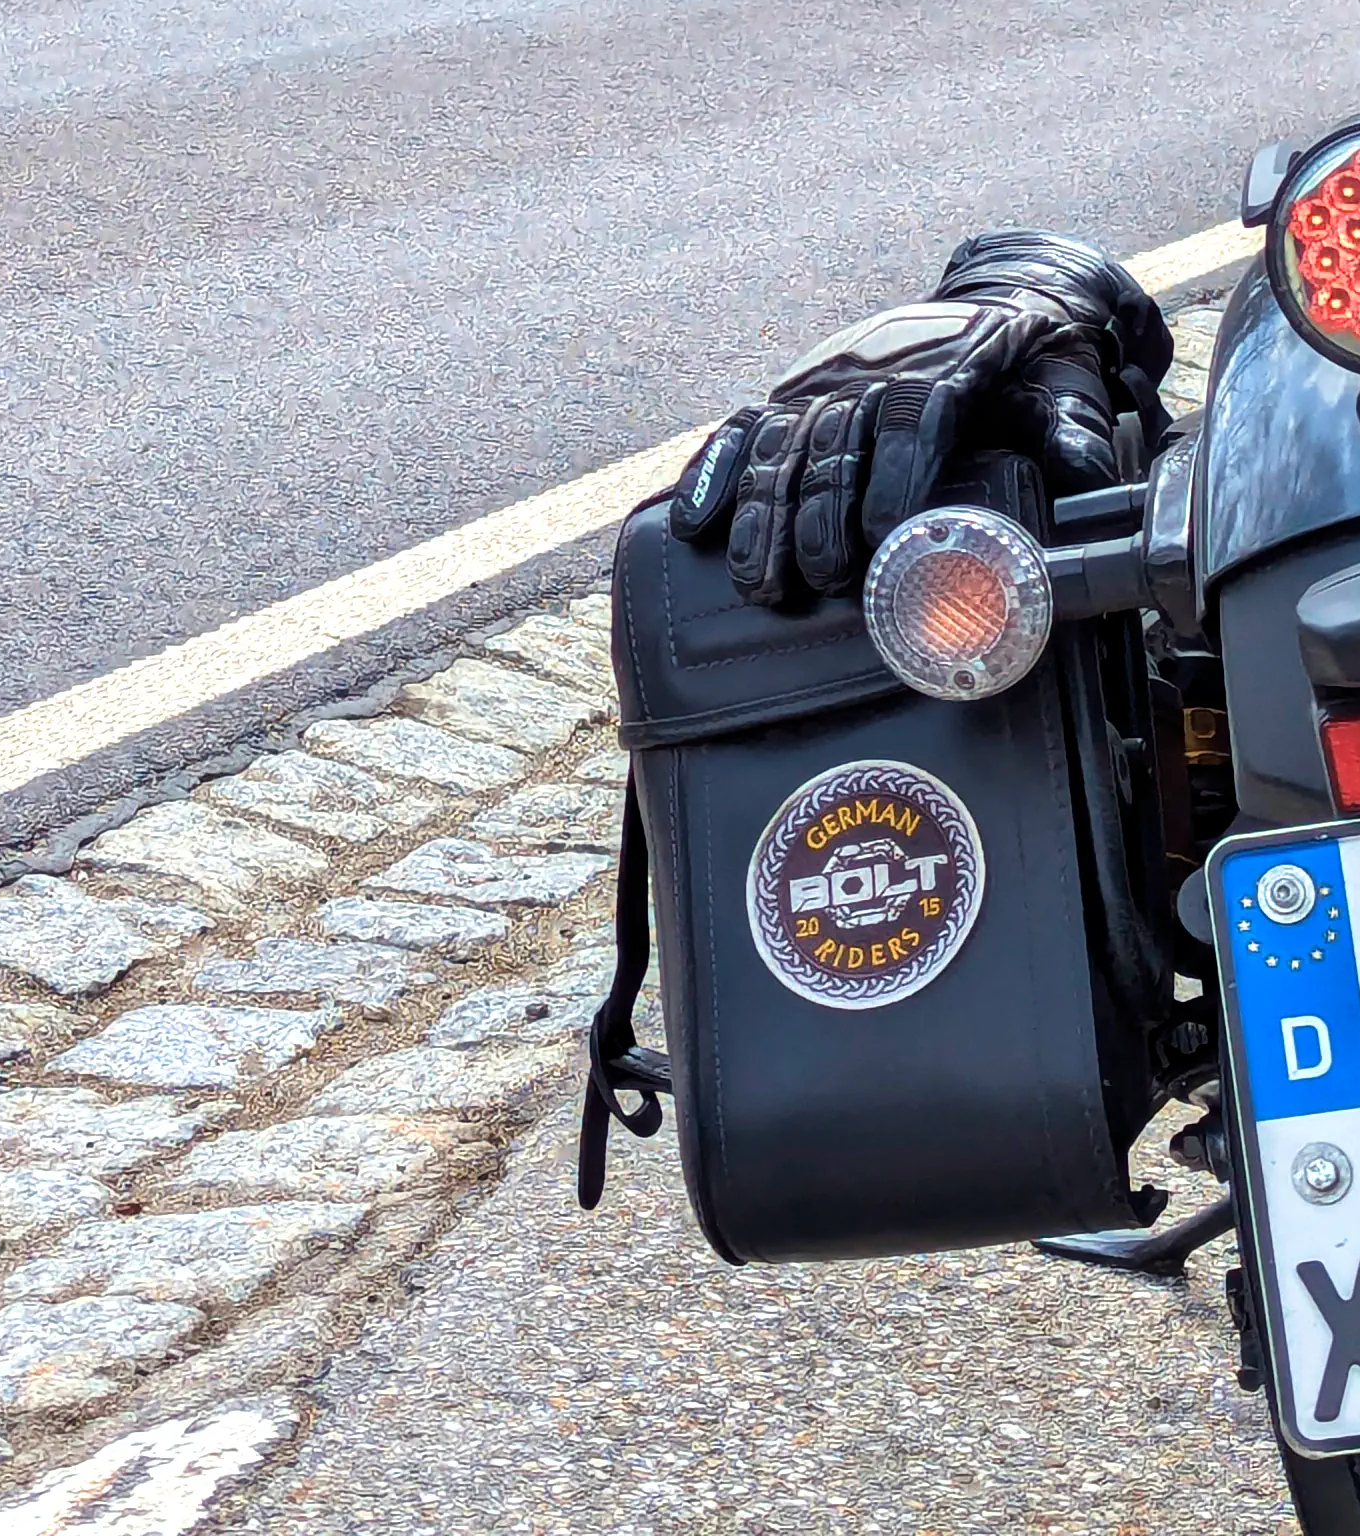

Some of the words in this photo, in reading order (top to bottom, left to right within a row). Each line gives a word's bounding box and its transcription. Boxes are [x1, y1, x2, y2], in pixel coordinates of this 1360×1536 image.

[805, 797, 922, 850] GERMAN
[789, 853, 949, 914] BOLT
[794, 915, 820, 938] 20
[917, 895, 942, 918] 15
[813, 926, 921, 969] RIDERS
[1279, 1014, 1334, 1082] D
